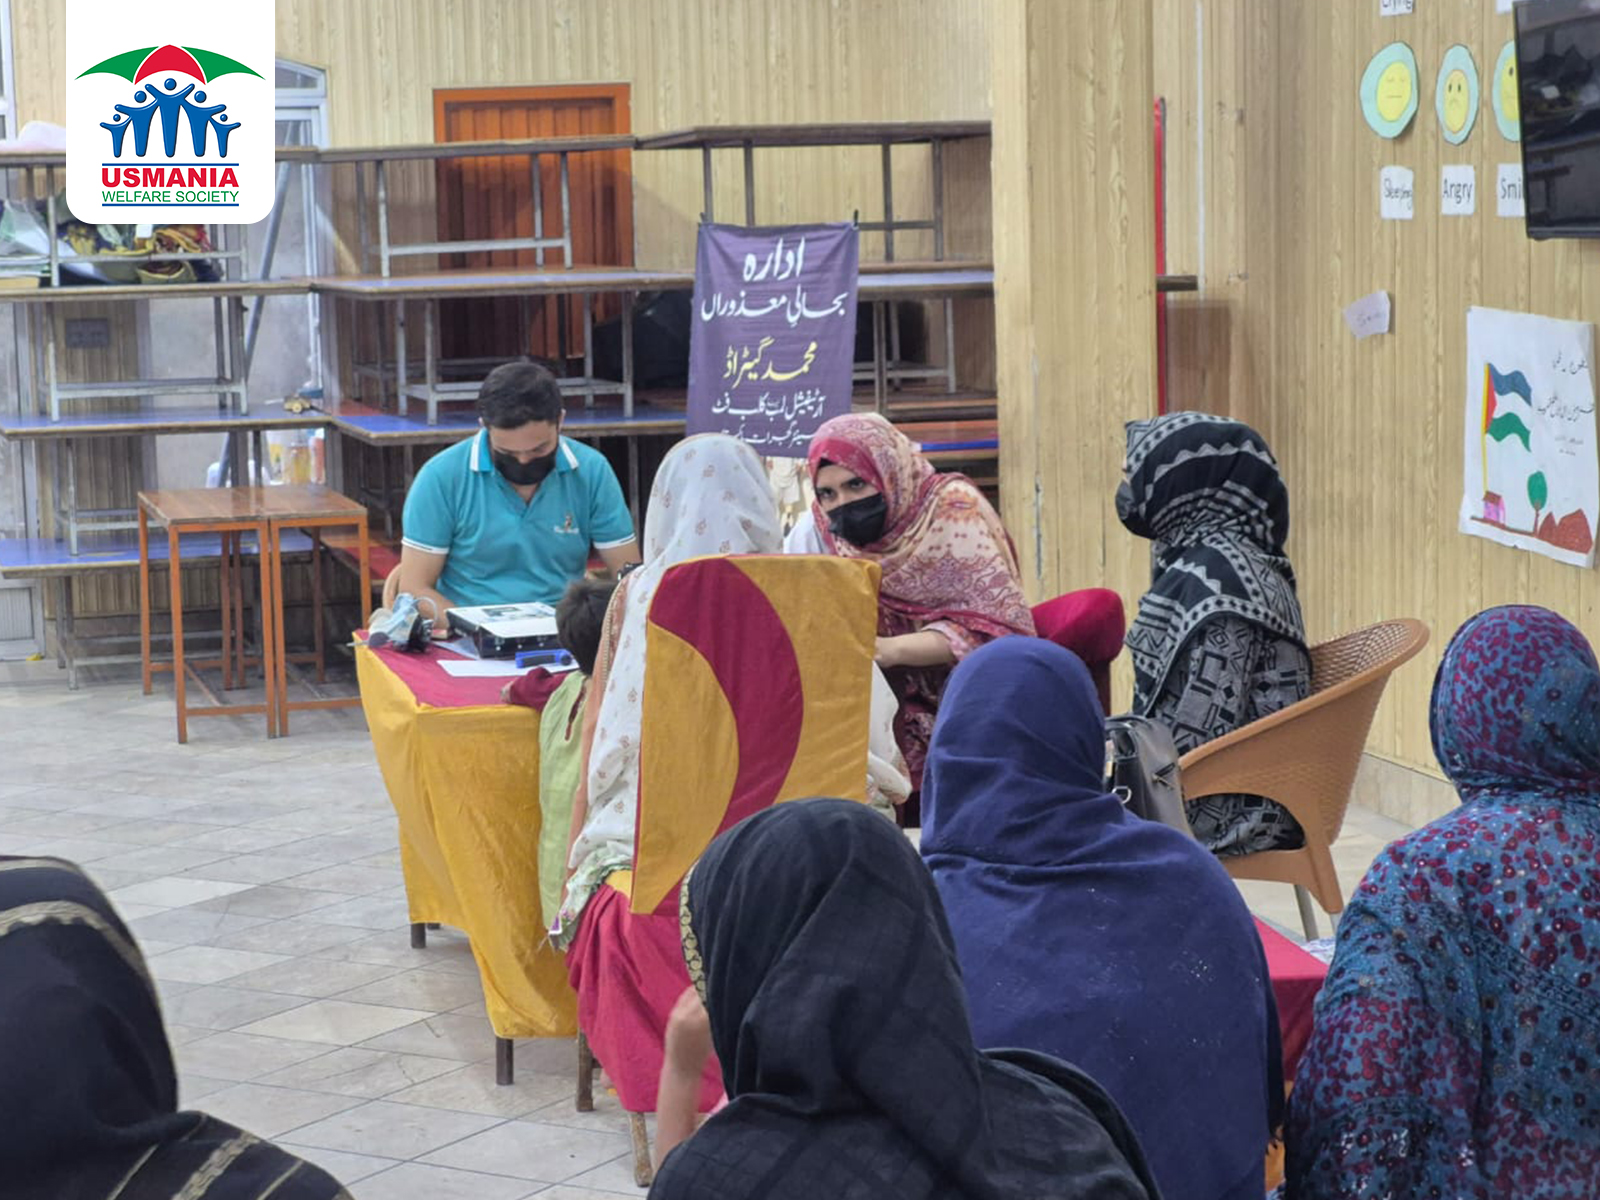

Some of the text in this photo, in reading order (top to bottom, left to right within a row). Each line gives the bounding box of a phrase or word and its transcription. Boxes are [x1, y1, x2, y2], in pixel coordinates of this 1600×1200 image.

[1442, 178, 1473, 204] Angry
[1500, 177, 1522, 200] Smi
[743, 237, 805, 282] ادارہ
[761, 341, 818, 381] محمد
